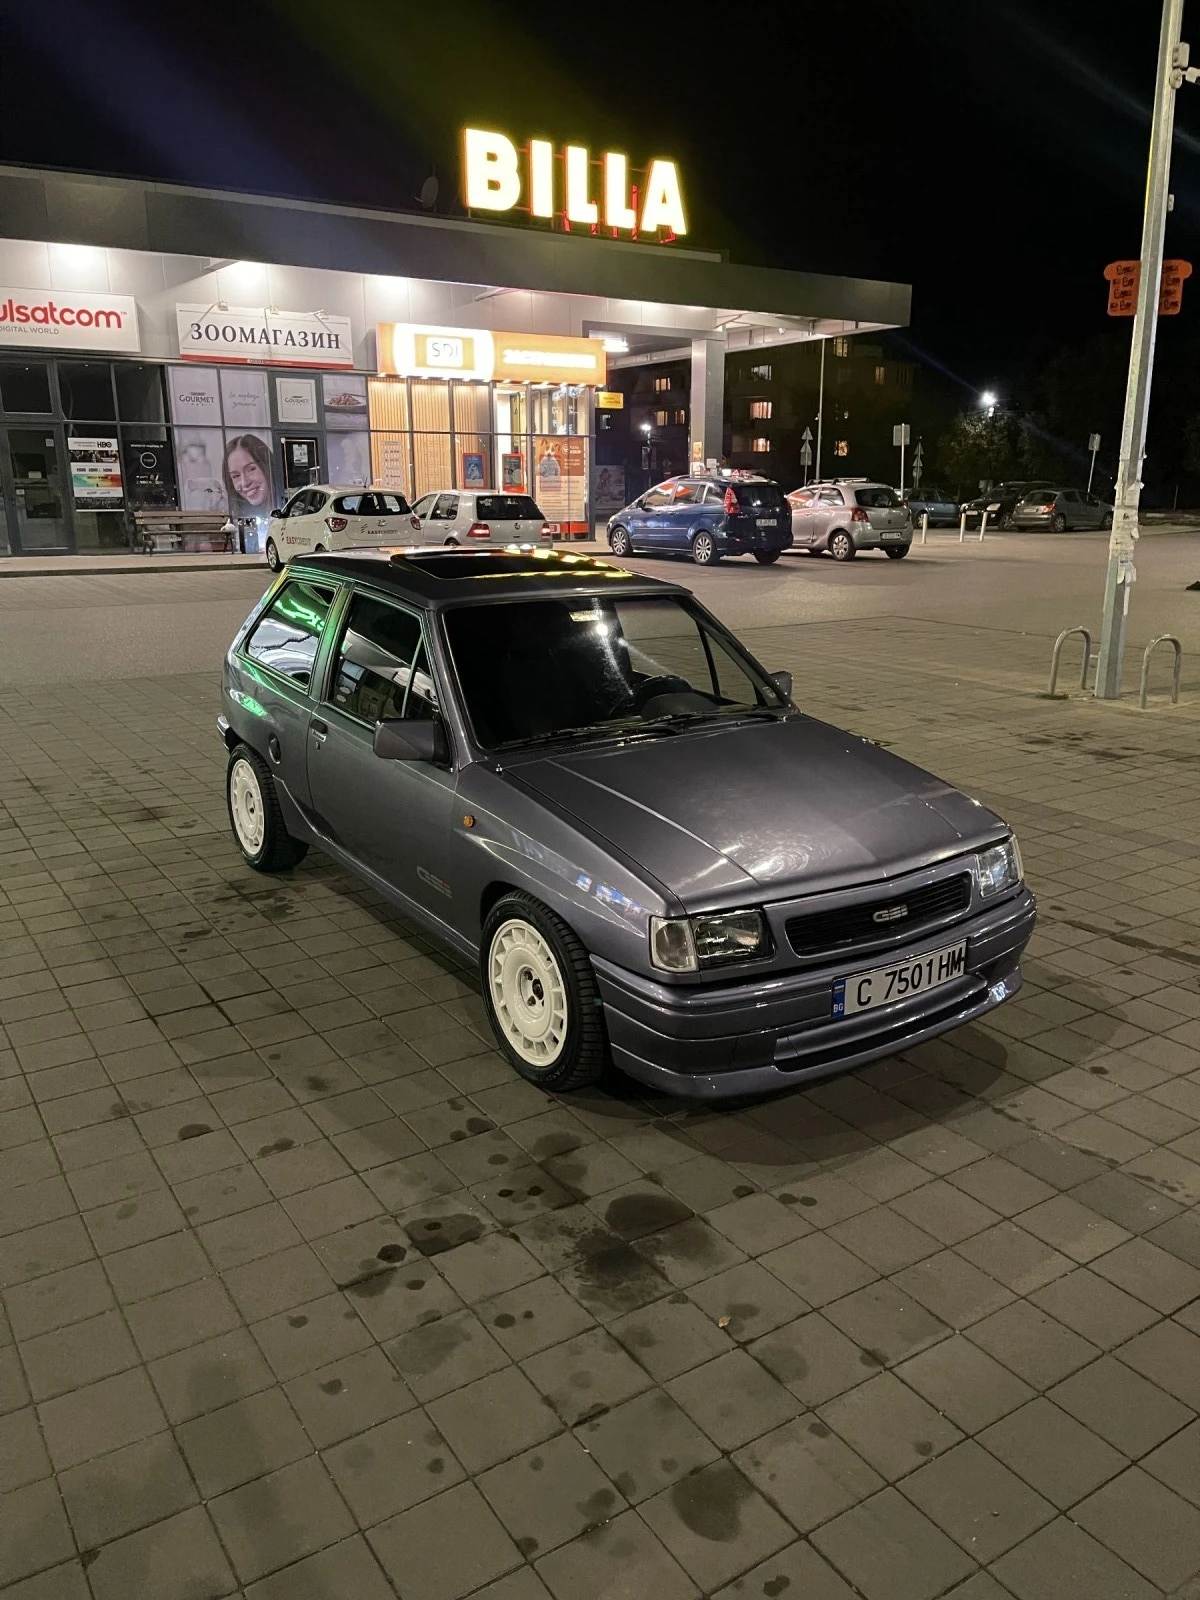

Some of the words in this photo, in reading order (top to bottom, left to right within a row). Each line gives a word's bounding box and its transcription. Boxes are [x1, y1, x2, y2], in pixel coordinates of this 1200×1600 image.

[464, 128, 687, 235] BILLA
[30, 327, 60, 335] WORLD
[190, 322, 341, 349] ЗООМАГАЗИН
[179, 394, 214, 404] GOURMET
[97, 441, 112, 449] HBO
[857, 978, 872, 1006] C
[833, 1003, 844, 1012] BG
